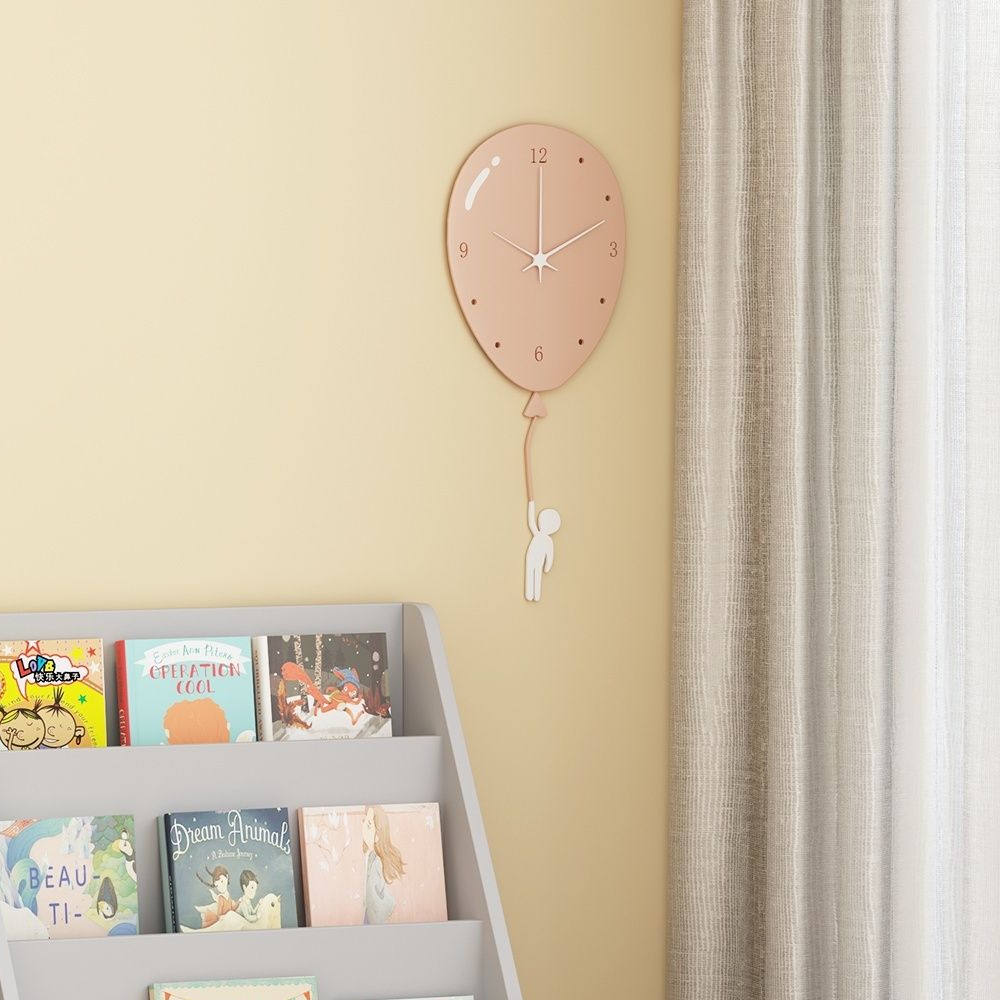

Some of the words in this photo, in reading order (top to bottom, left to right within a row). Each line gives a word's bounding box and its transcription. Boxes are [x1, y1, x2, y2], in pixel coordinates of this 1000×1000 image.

[530, 147, 548, 164] 12
[459, 241, 468, 258] 9
[609, 241, 618, 258] 3
[534, 345, 544, 362] 6
[34, 671, 81, 683] 快乐大鼻子
[150, 662, 241, 680] OPERATION
[176, 679, 216, 695] COOL
[170, 820, 224, 861] Dream
[227, 810, 292, 856] Animals
[28, 864, 102, 891] BEAU-
[48, 902, 83, 927] TI-
